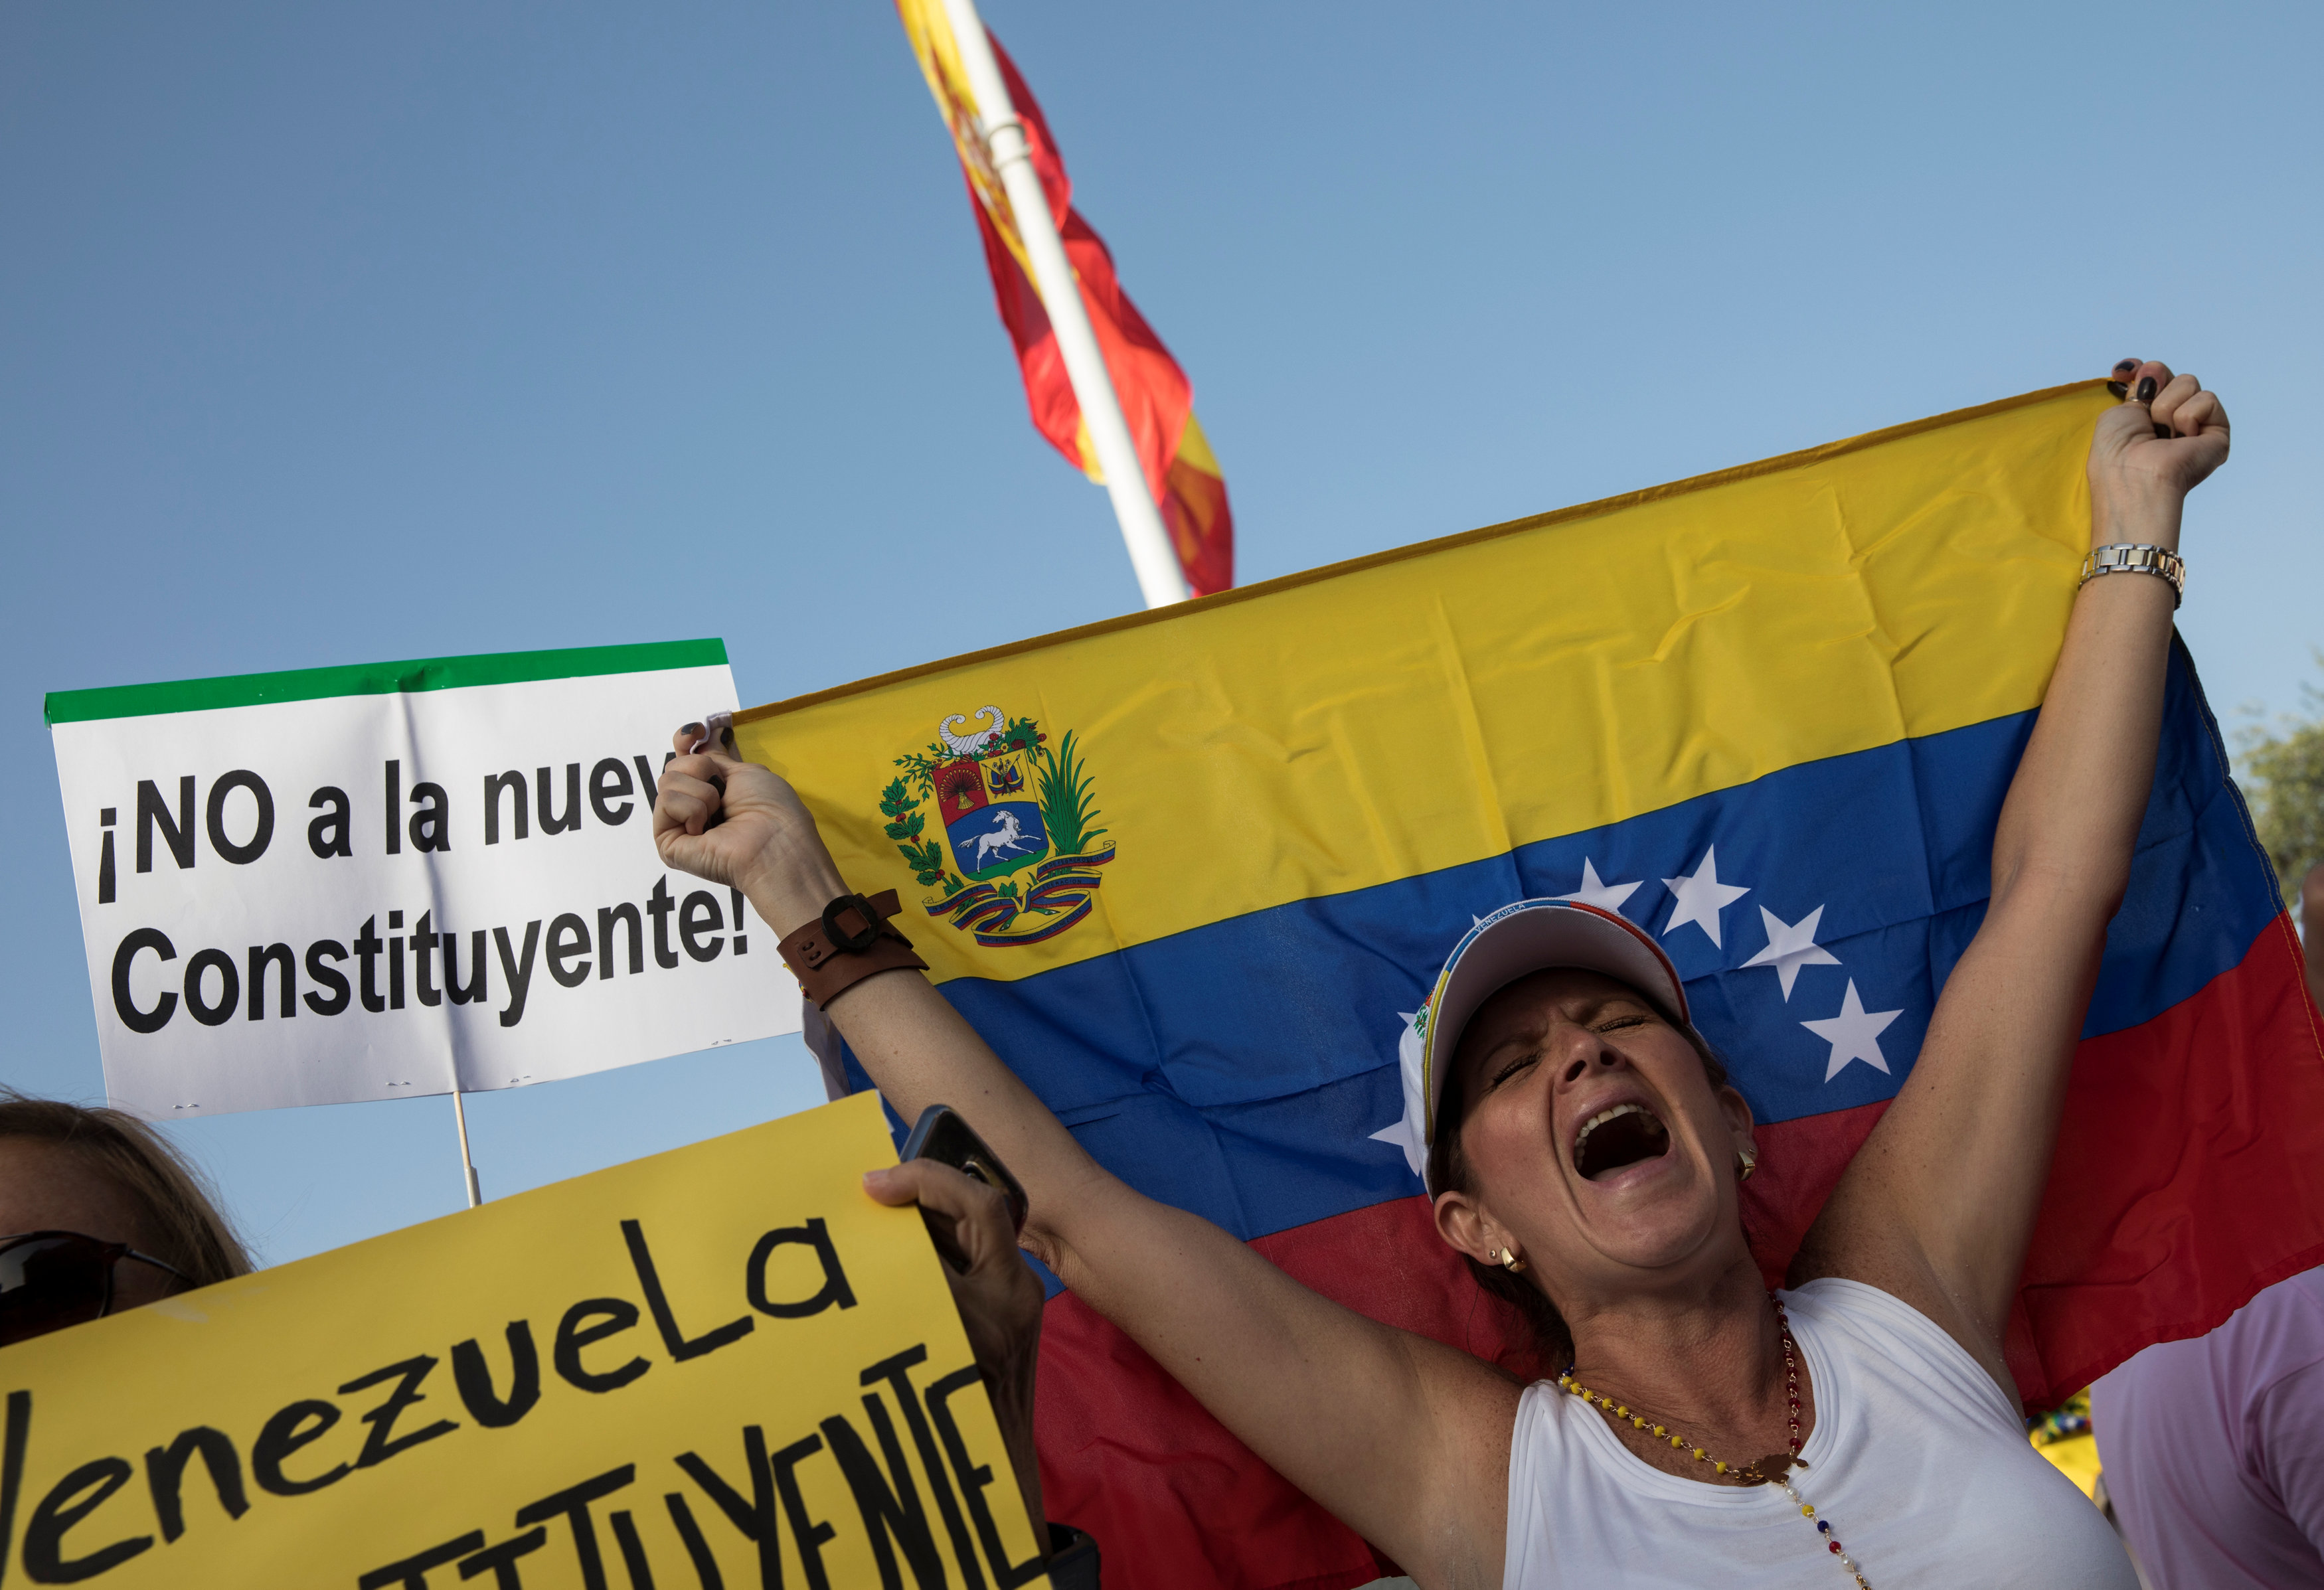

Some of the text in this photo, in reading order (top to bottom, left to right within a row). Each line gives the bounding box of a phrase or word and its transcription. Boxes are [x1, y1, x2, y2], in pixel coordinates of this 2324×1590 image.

[99, 752, 676, 904] ¡NO a la nuev
[112, 874, 748, 1033] Constituyente!
[1475, 904, 1525, 932] VENEZUELA
